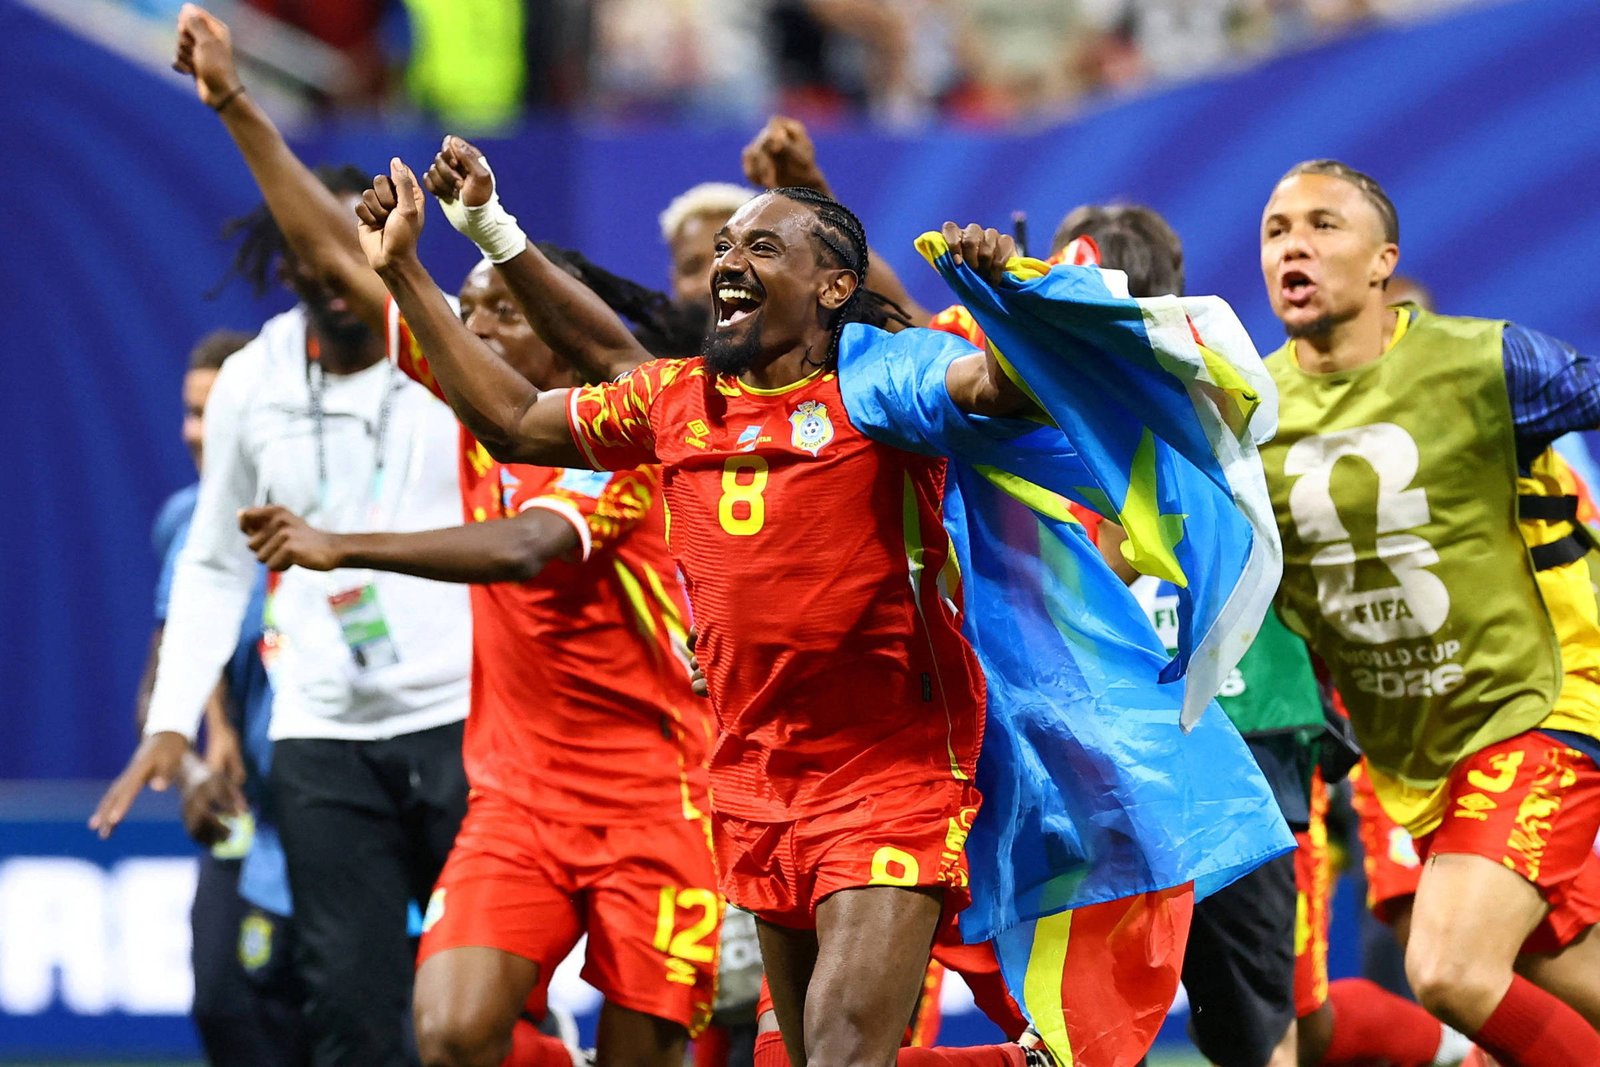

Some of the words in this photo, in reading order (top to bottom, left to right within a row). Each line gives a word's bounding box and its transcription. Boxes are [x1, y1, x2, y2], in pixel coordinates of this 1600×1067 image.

[719, 455, 769, 535] 8
[1355, 598, 1413, 623] FIFA
[1340, 647, 1412, 668] WORLD
[1415, 639, 1461, 663] CUP
[1350, 663, 1466, 699] 2026
[653, 885, 718, 963] 12
